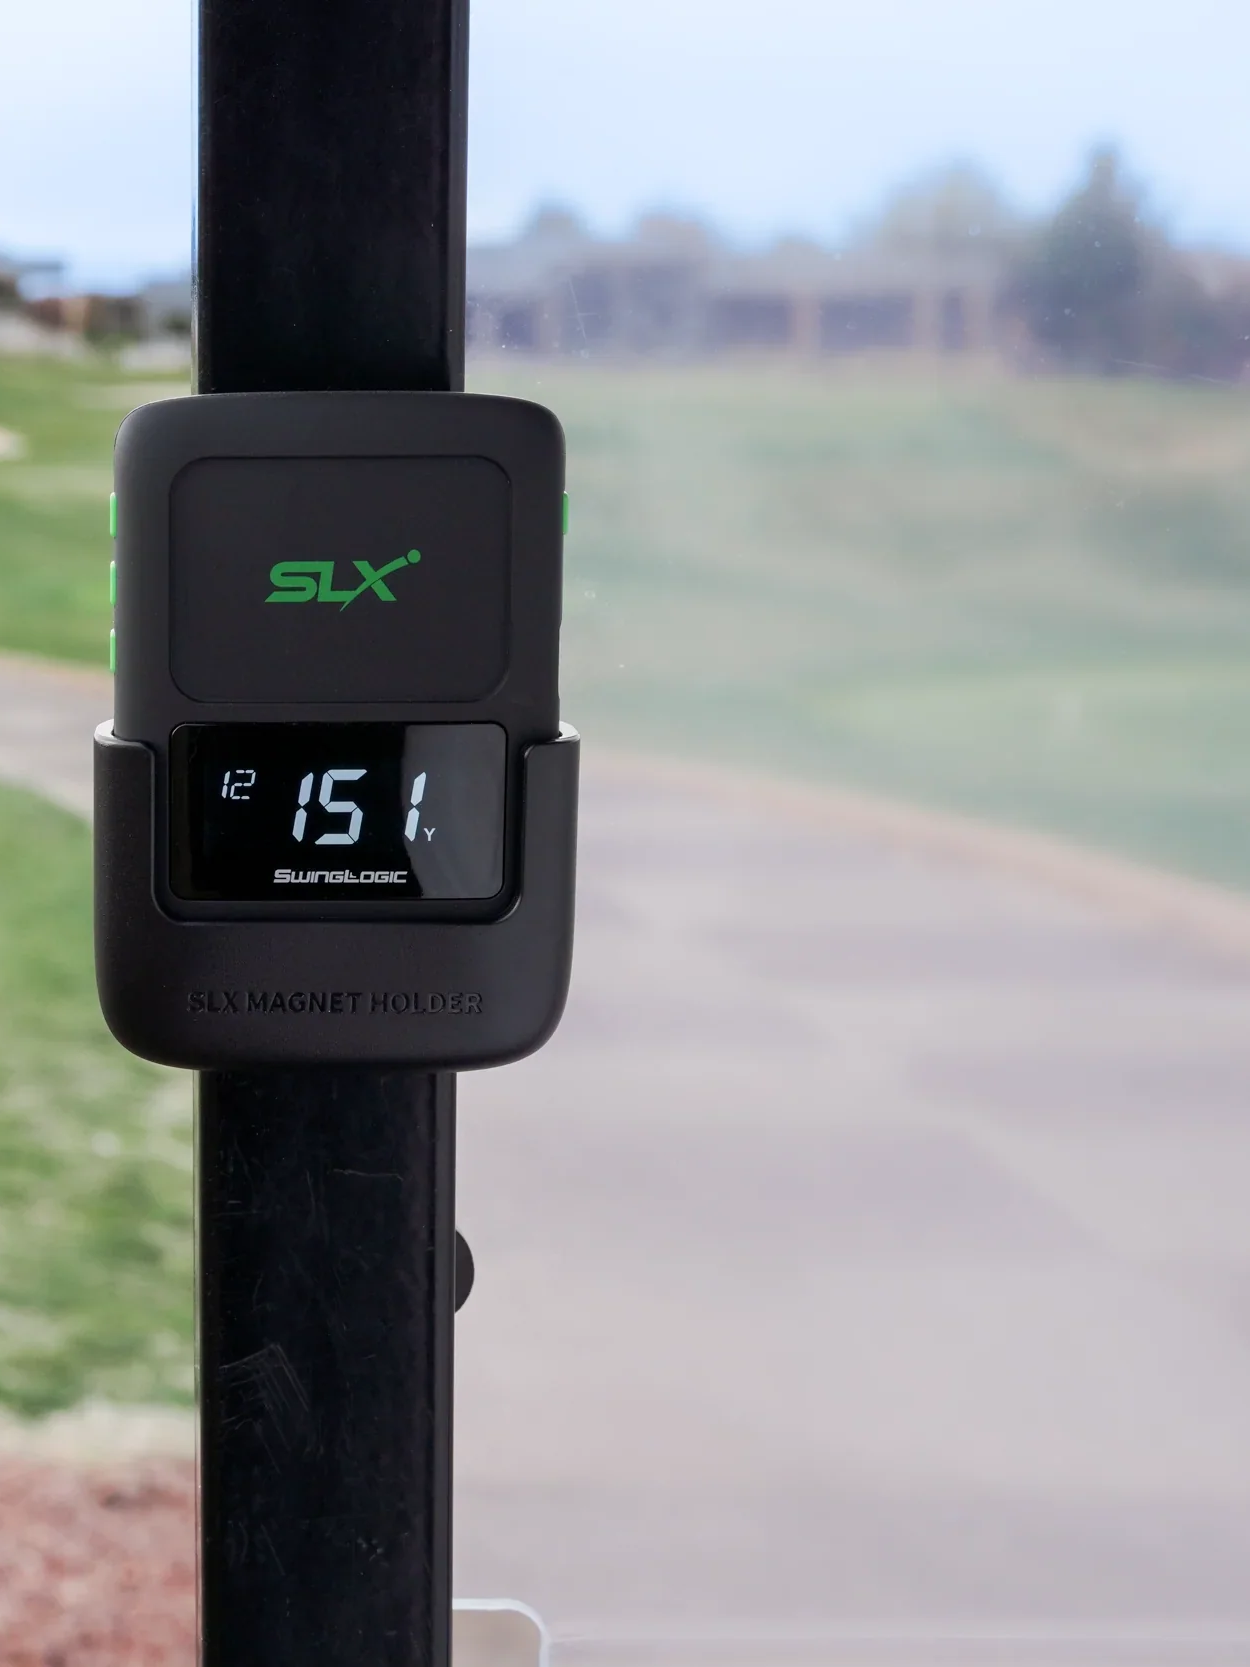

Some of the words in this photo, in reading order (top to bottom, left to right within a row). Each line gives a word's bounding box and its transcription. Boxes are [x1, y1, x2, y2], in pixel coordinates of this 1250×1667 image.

[264, 549, 422, 612] SLX
[221, 769, 256, 800] 12
[292, 768, 426, 845] 151
[424, 827, 436, 842] Y
[187, 991, 239, 1014] SLX
[246, 991, 363, 1014] MAGNET
[371, 992, 483, 1015] HOLDER
